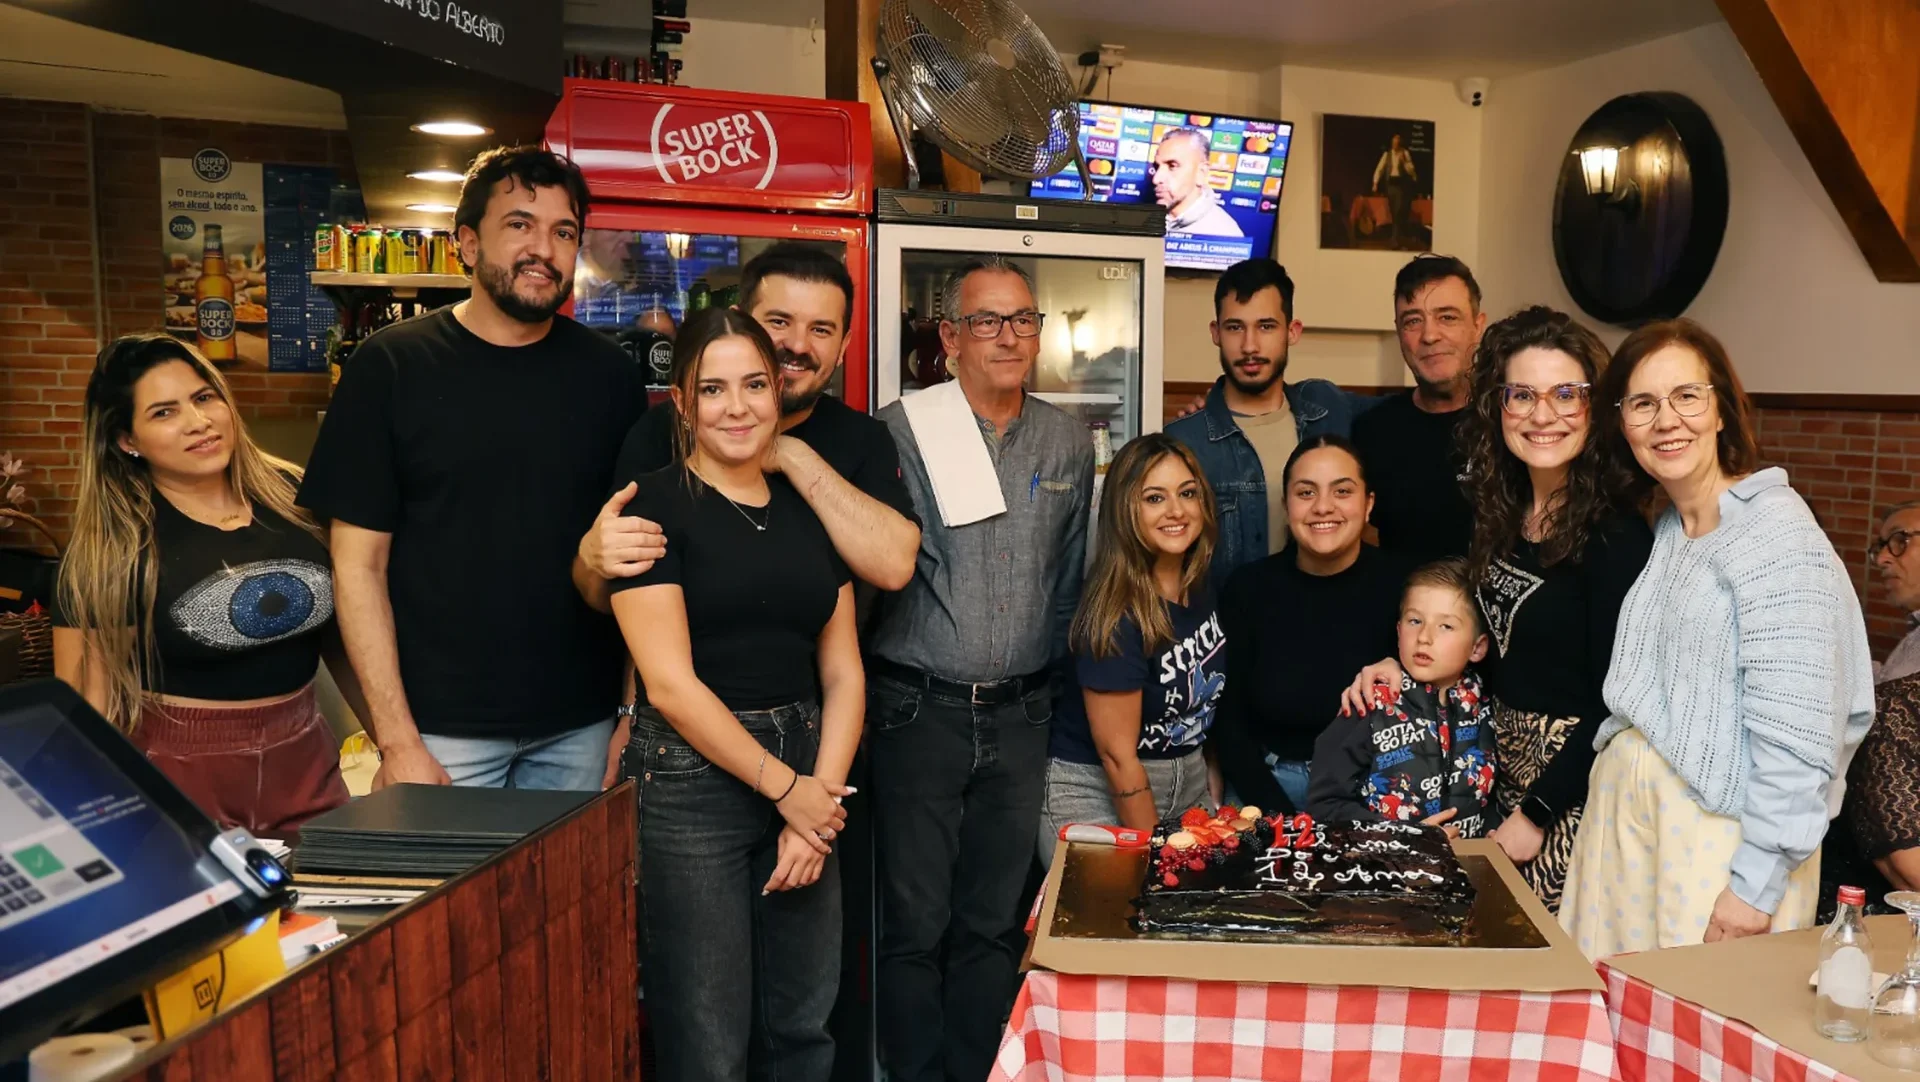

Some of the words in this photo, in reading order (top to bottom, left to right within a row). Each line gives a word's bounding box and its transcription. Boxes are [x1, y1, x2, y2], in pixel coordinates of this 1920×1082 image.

[446, 2, 504, 45] ALBERTO
[665, 113, 756, 157] SUPER
[1090, 140, 1115, 149] QATAR
[198, 157, 225, 165] SUPER
[678, 137, 761, 181] BOCK
[200, 164, 224, 172] BOCK
[177, 188, 184, 197] O
[186, 190, 214, 198] mesmo
[214, 201, 232, 210] todo
[172, 223, 193, 232] 2026
[1166, 242, 1179, 250] DIZ
[200, 309, 232, 319] SUPER
[201, 319, 230, 328] BOCK
[653, 356, 672, 364] BOC
[1373, 722, 1415, 745] GOTTA
[1379, 736, 1400, 753] GO
[1264, 811, 1316, 849] 12
